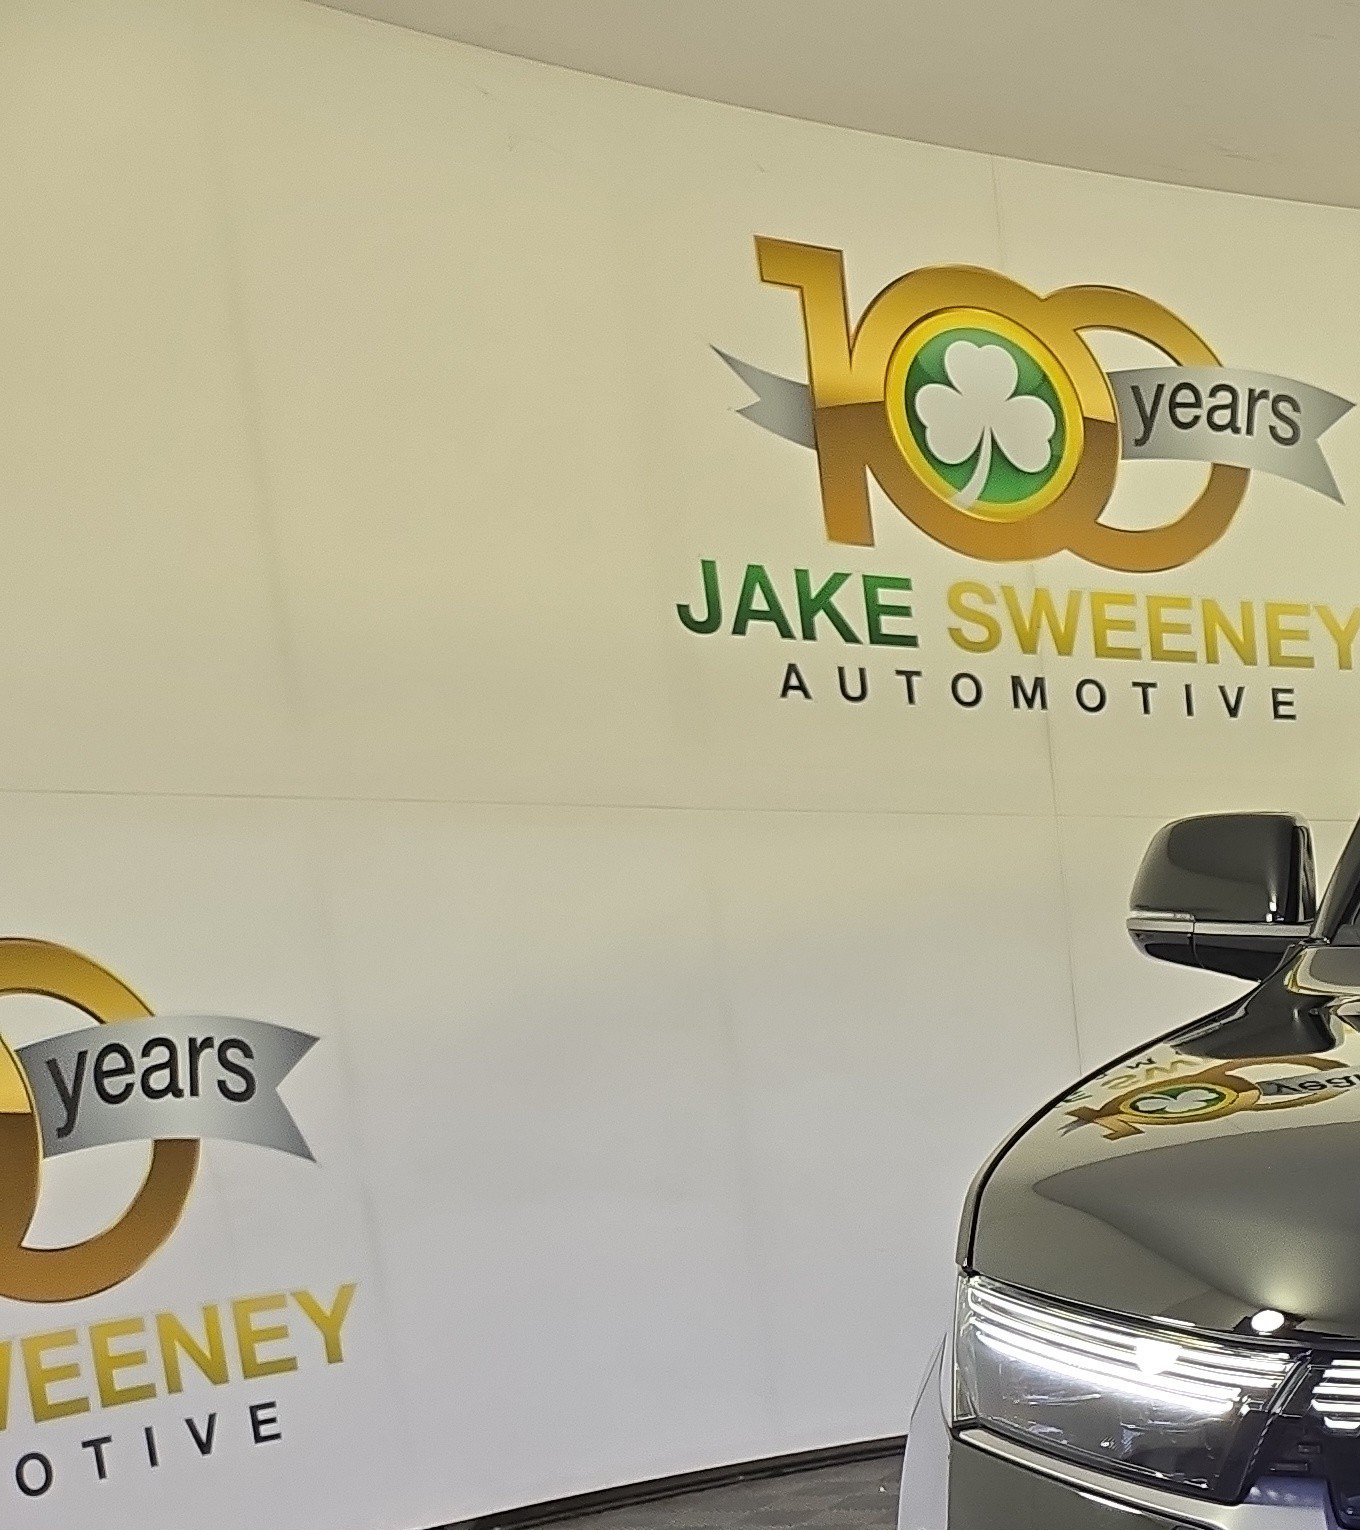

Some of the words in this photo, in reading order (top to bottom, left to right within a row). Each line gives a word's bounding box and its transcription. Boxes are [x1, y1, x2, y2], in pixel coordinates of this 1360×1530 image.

[1130, 381, 1302, 447] years
[675, 558, 919, 649] JAKE
[780, 662, 1298, 721] AUTOMOTIVE
[46, 1035, 257, 1138] years
[0, 1283, 357, 1430] EENEY
[15, 1401, 283, 1497] OTIVE
